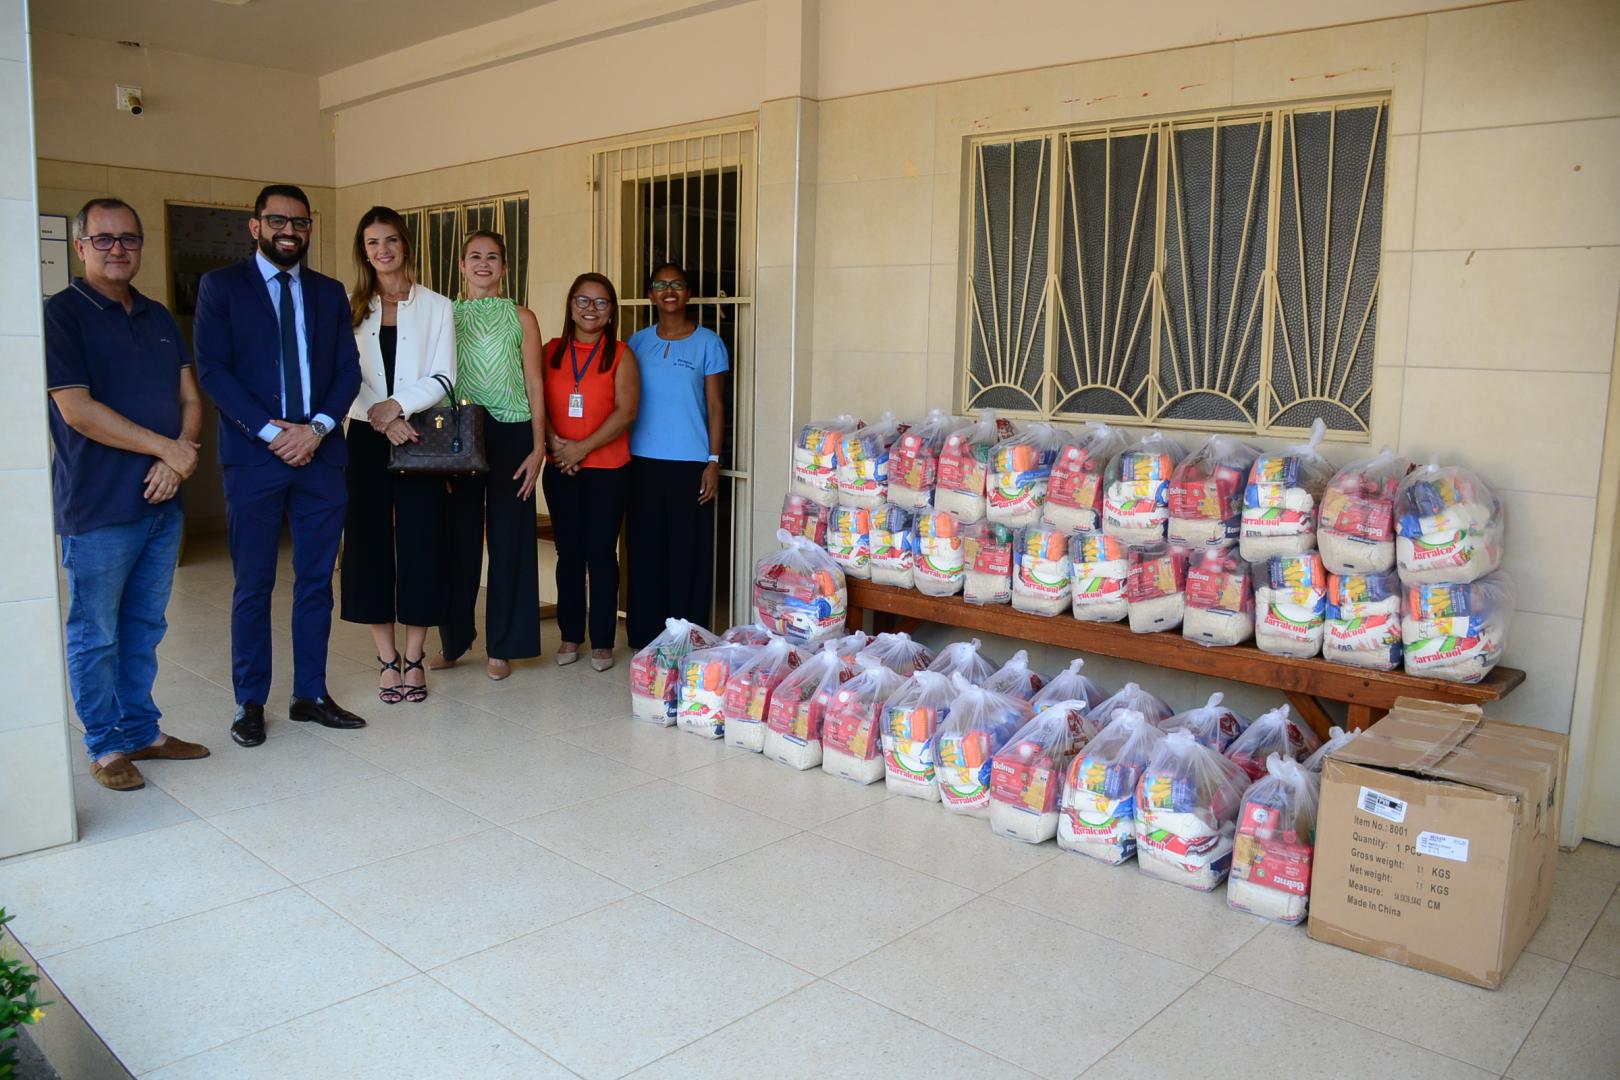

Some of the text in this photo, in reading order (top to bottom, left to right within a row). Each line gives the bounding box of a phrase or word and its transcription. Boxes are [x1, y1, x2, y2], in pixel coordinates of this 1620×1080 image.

[993, 760, 1015, 775] Belma
[1354, 815, 1371, 827] Item
[1389, 824, 1408, 836] 8001
[1352, 831, 1388, 849] Quantity:
[1396, 844, 1400, 852] 1
[1404, 844, 1422, 857] PC
[1351, 847, 1374, 862] Gross
[1375, 854, 1405, 869] weight:
[1432, 867, 1451, 879] KGS
[1273, 875, 1305, 891] Belma
[1349, 863, 1363, 876] Net
[1363, 867, 1393, 883] weight:
[1430, 883, 1449, 896] KGS
[1347, 895, 1367, 909] Made
[1378, 903, 1401, 917] China
[1348, 879, 1441, 911] Measure: CM
